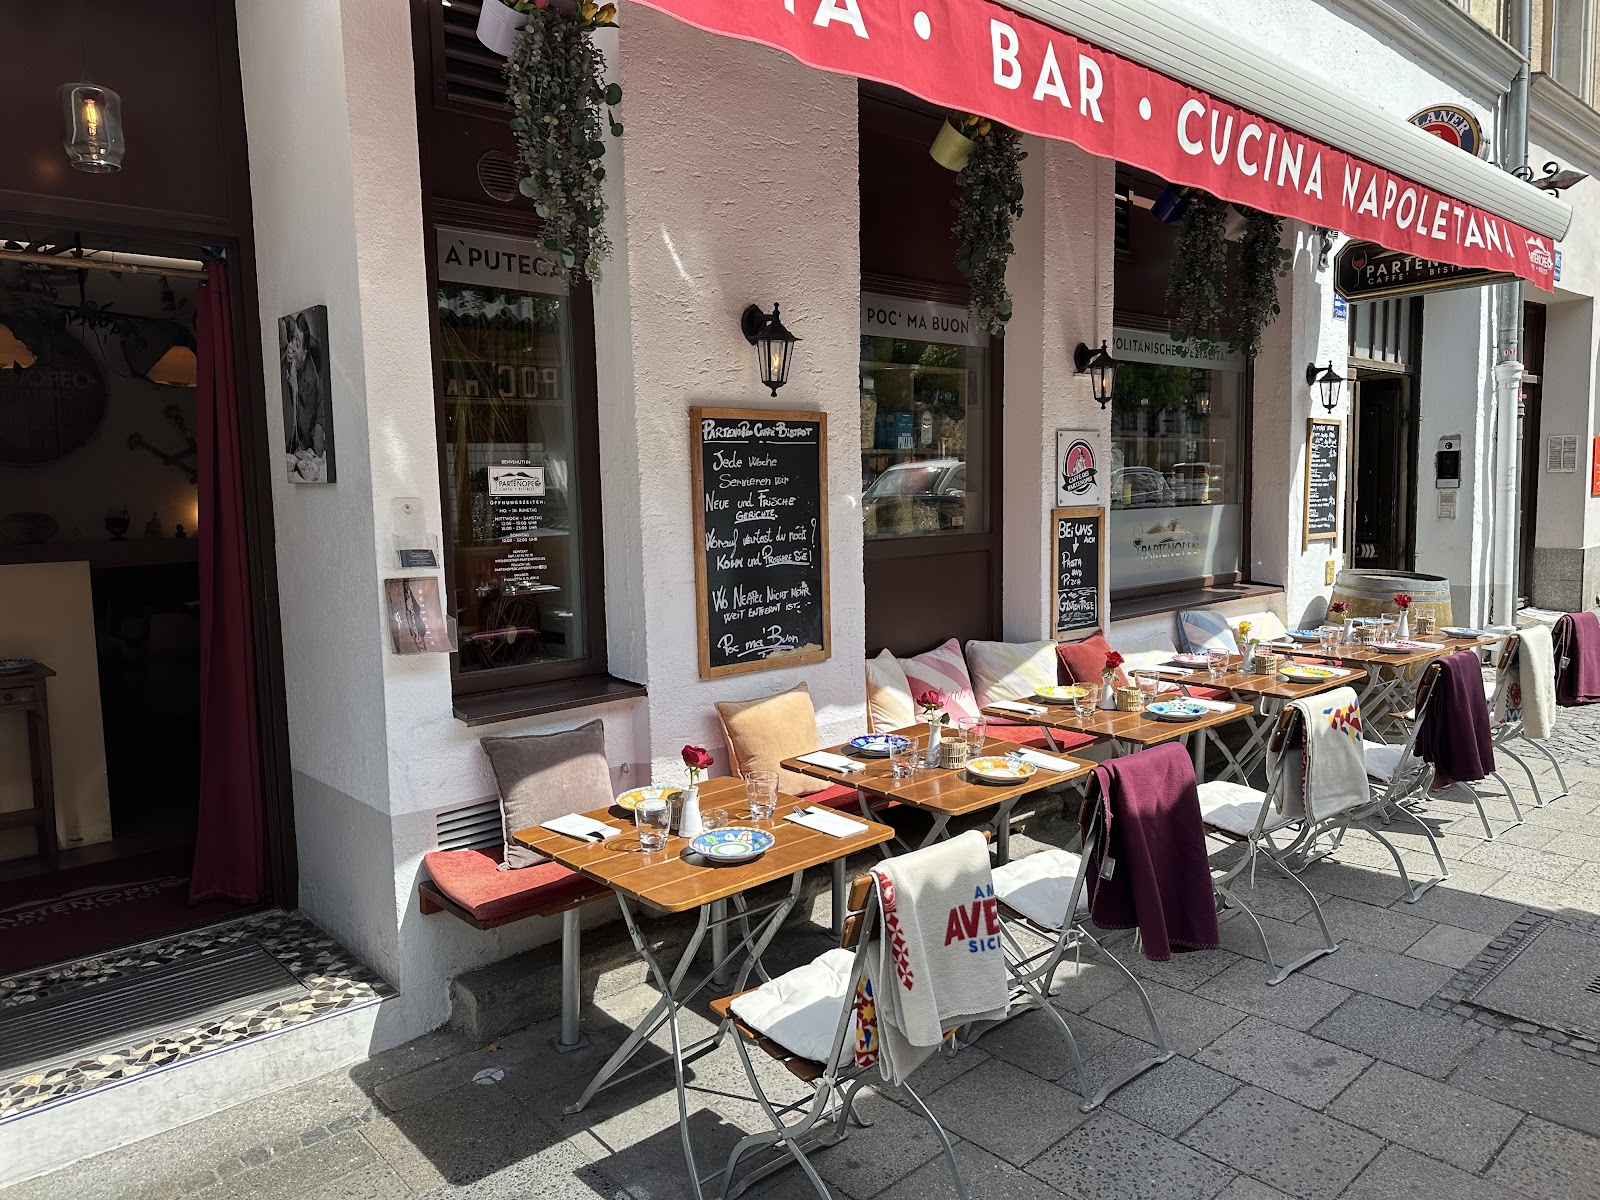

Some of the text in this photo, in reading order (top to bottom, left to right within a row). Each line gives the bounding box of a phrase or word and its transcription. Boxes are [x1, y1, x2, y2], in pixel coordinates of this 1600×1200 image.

[990, 18, 1104, 123] BAR
[1177, 98, 1323, 200] CUCINA
[1429, 264, 1472, 277] BISTR
[907, 313, 928, 330] MA
[713, 450, 778, 471] Jede Woche
[719, 473, 772, 489] Servieren
[737, 492, 755, 508] und
[776, 526, 786, 542] du
[748, 552, 762, 568] und
